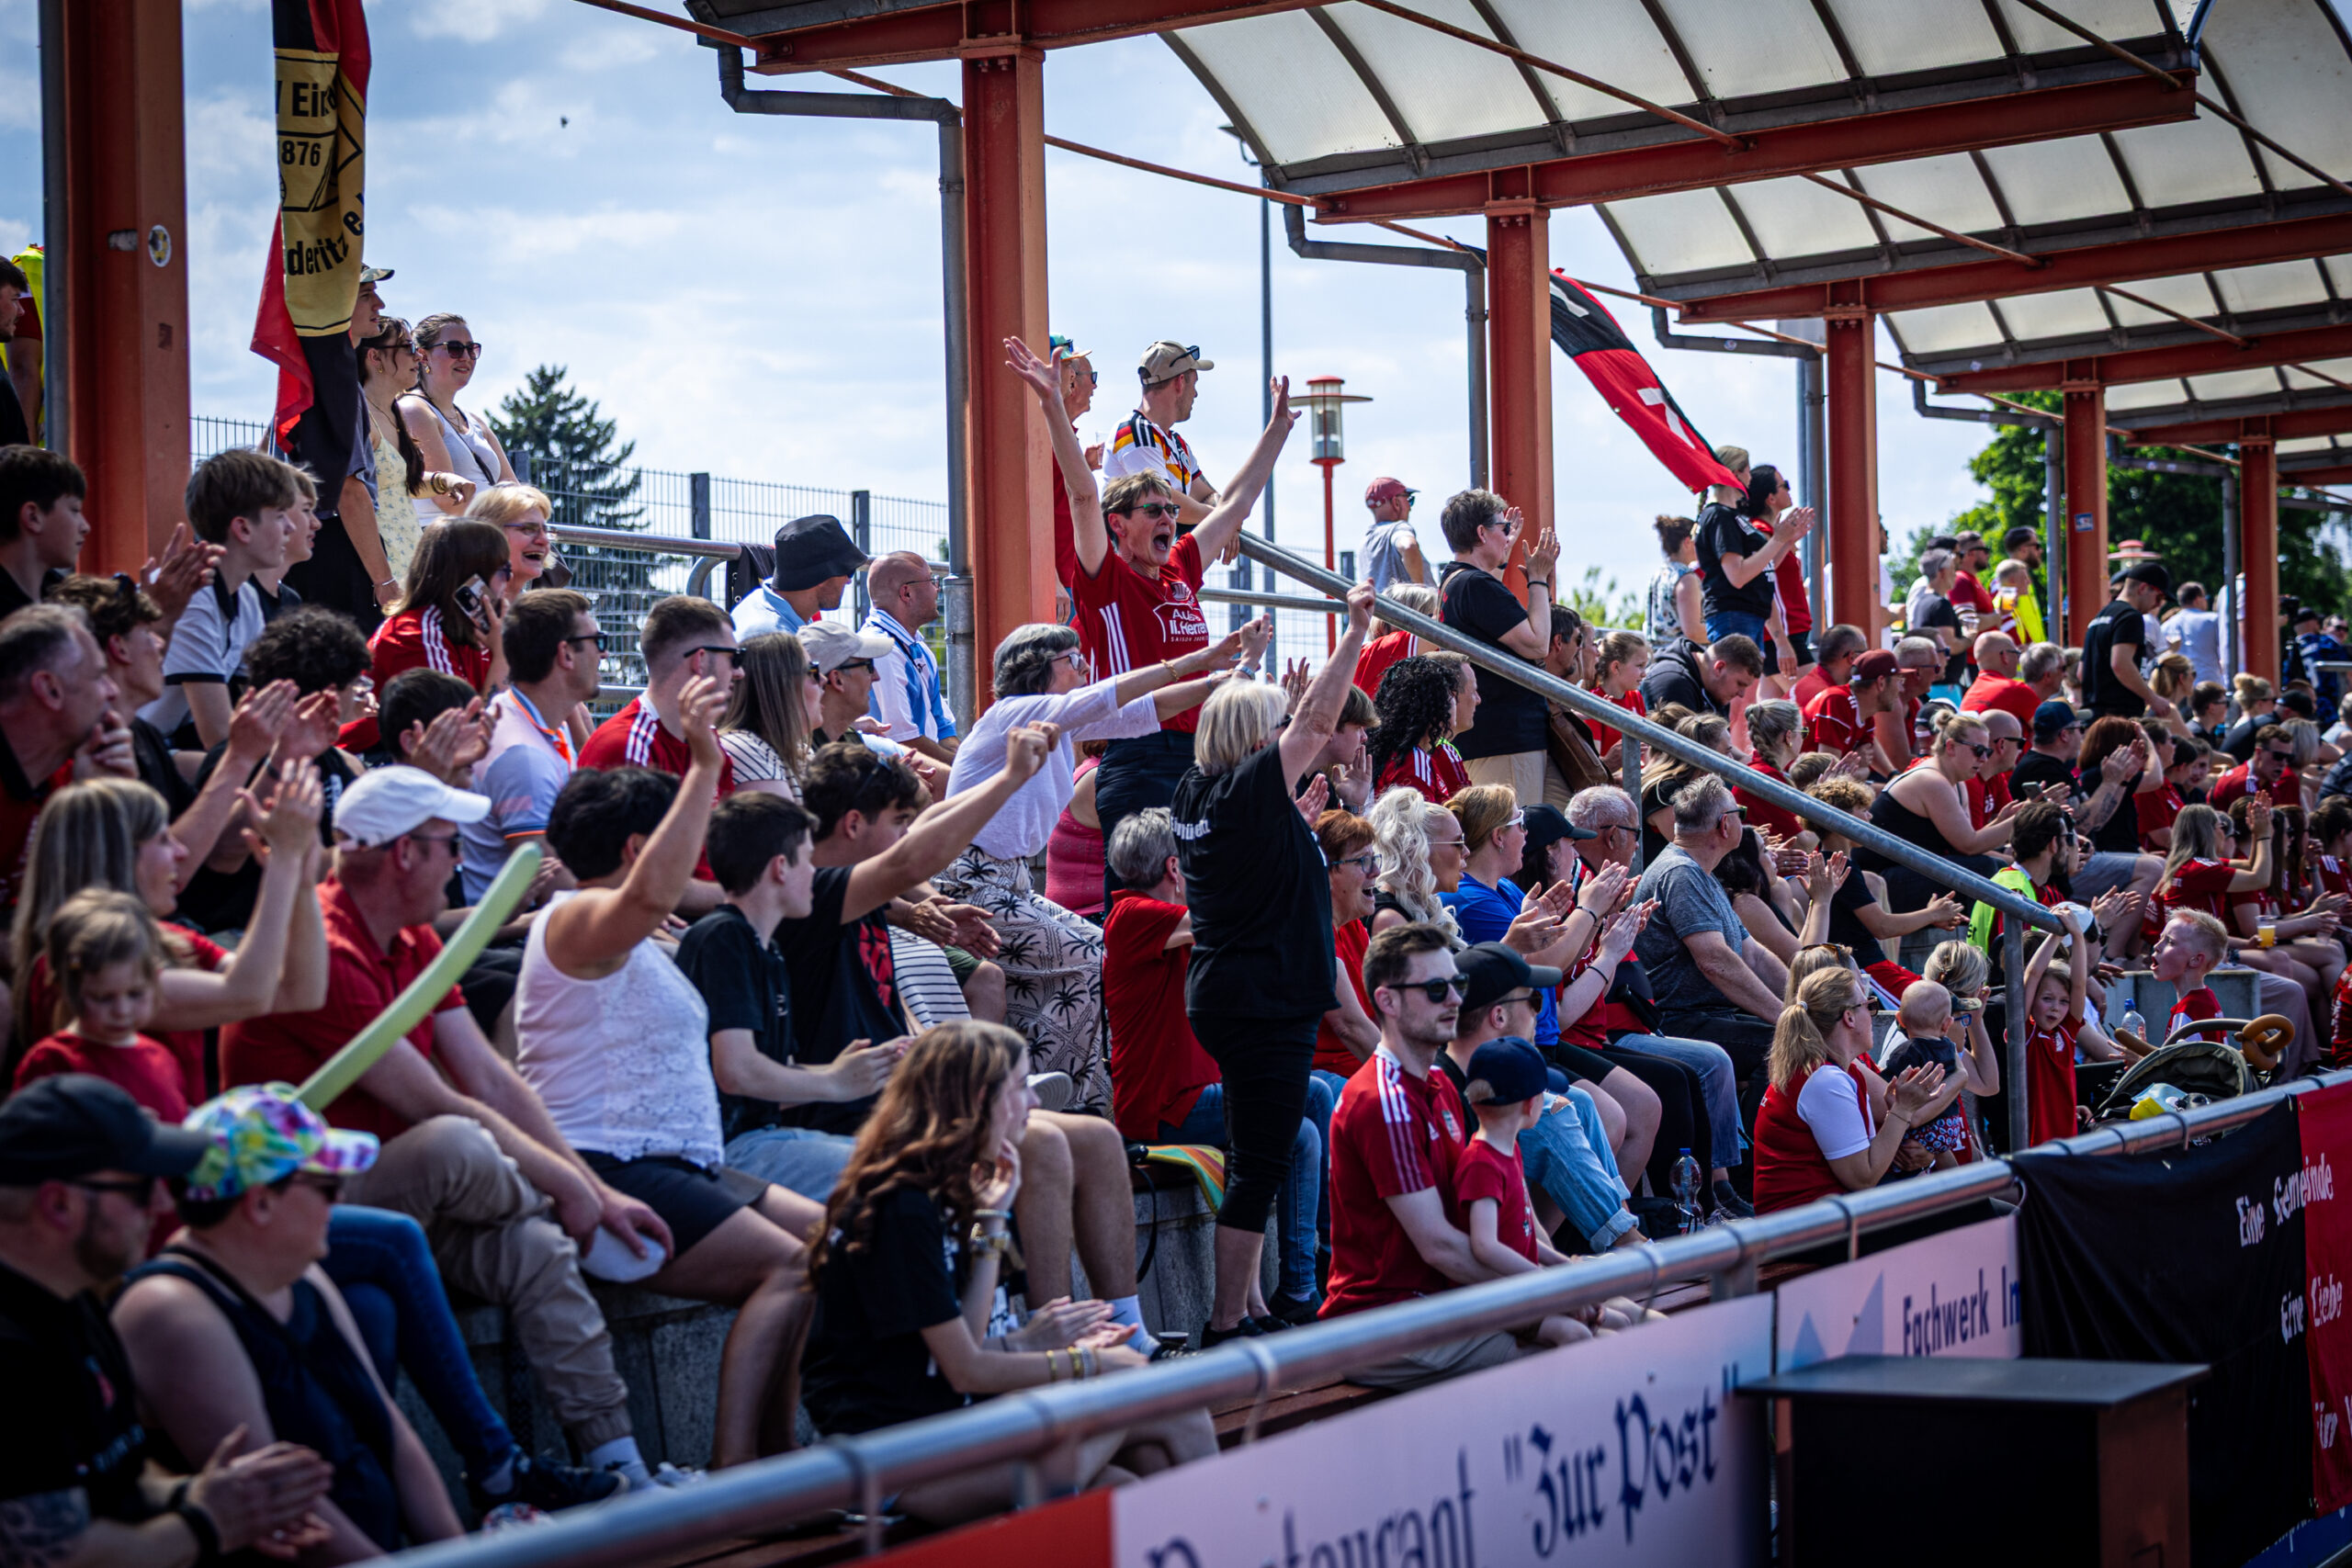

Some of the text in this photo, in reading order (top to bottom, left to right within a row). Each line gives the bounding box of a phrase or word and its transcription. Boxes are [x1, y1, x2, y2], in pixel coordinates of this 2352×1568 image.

[277, 140, 322, 167] 876
[2235, 1152, 2335, 1248] Eine Gemeinde
[1903, 1267, 1990, 1358] Fachwerk
[2311, 1273, 2343, 1328] Liebe
